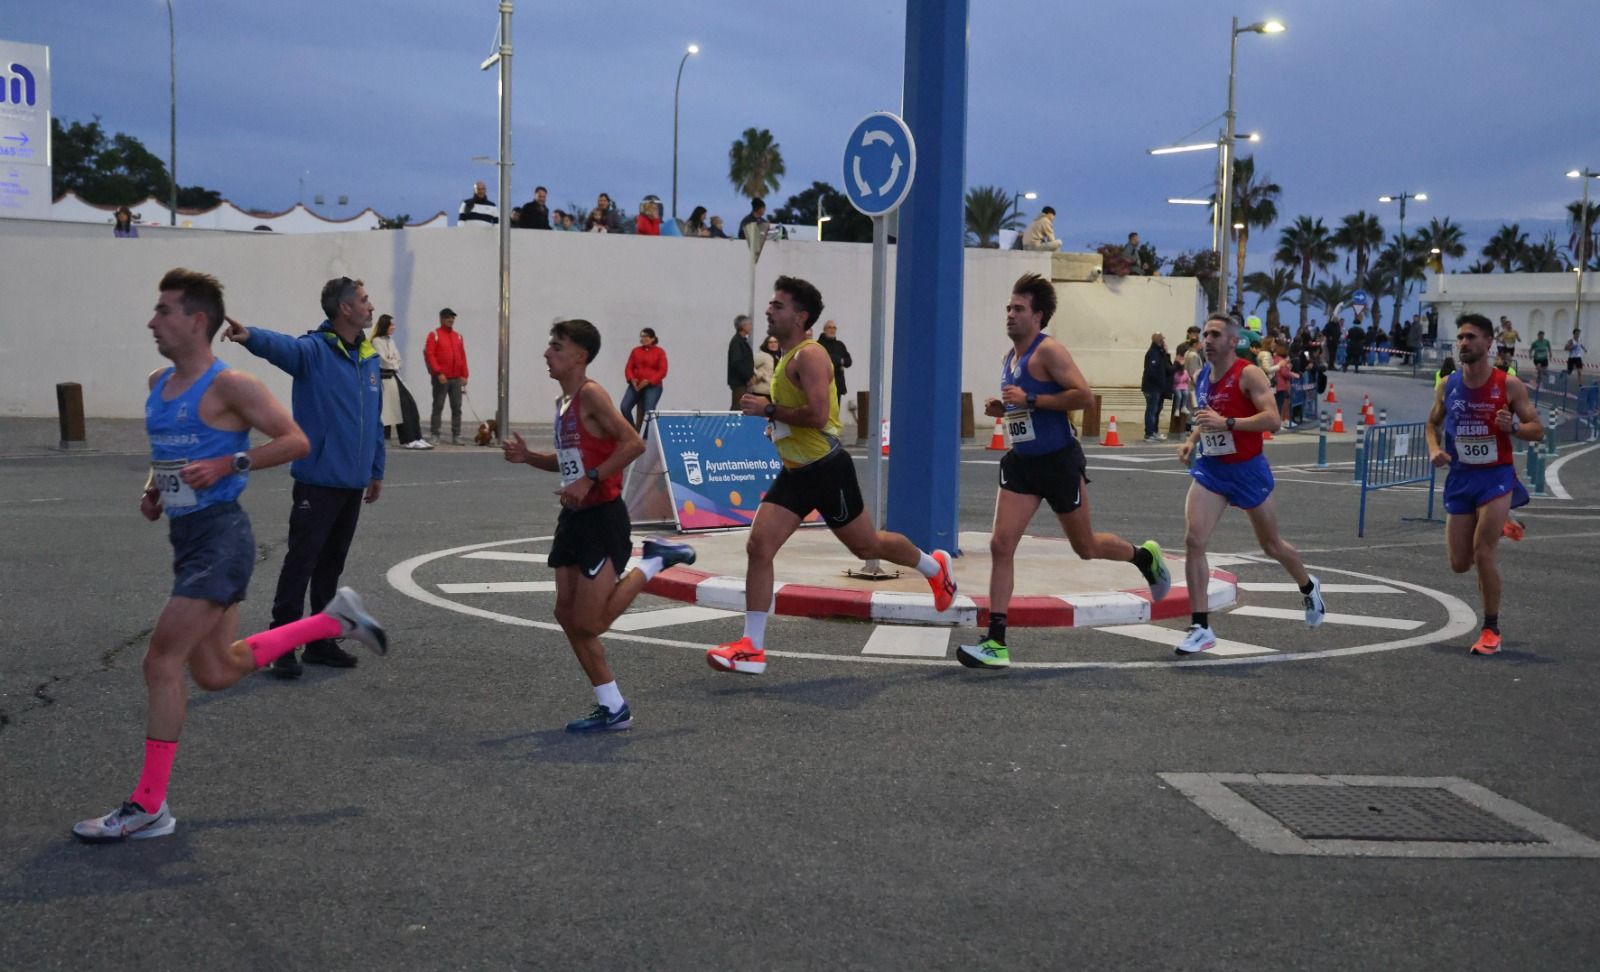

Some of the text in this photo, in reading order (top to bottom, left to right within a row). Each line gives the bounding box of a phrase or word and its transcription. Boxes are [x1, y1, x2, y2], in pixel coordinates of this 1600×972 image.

[1009, 421, 1027, 437] 406
[1205, 434, 1226, 447] 812
[1464, 444, 1489, 456] 360
[705, 458, 781, 473] Ayuntamiento de
[708, 473, 723, 482] Área
[731, 474, 756, 482] Deporte
